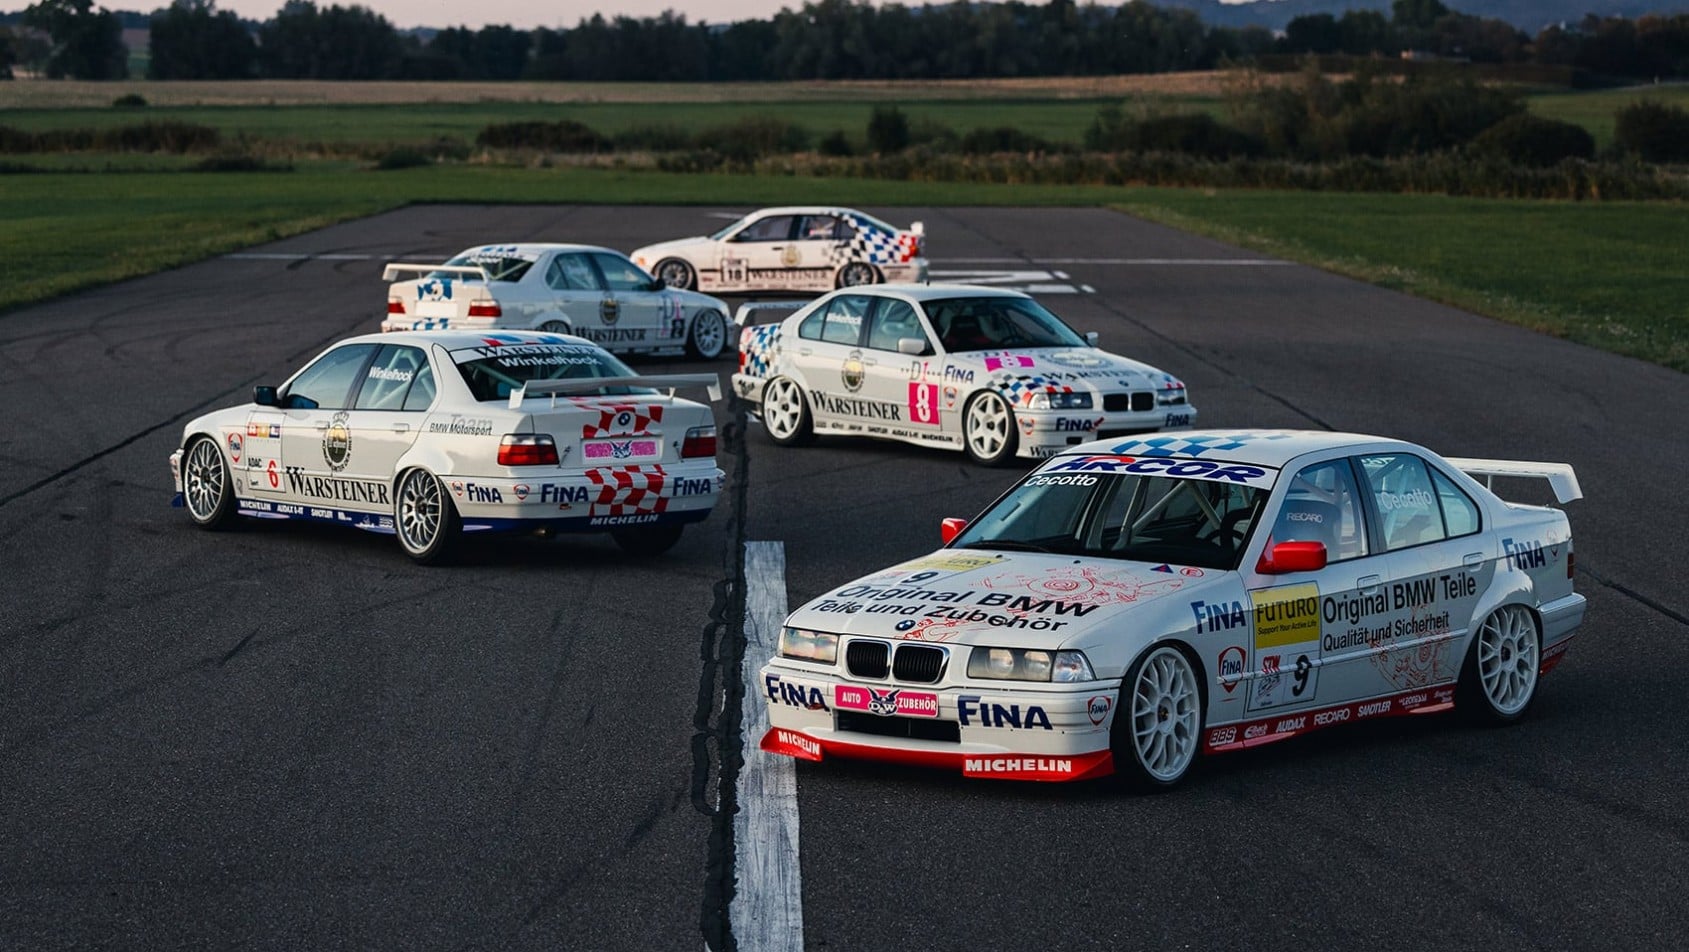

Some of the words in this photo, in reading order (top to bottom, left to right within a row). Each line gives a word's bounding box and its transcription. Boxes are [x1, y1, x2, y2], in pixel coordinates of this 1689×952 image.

[498, 356, 602, 368] Winkelhock
[368, 366, 413, 382] Winkelhock
[944, 364, 974, 384] FINA
[810, 389, 900, 421] WARSTEINER
[917, 383, 931, 422] 8
[430, 422, 449, 432] BMW
[449, 424, 492, 437] Motorsport
[1055, 417, 1092, 432] FINA
[1165, 413, 1190, 427] FINA
[267, 460, 279, 488] 6
[1045, 456, 1266, 483] ARCOR
[286, 466, 390, 504] WARSTEINER
[672, 476, 711, 496] FINA
[1024, 473, 1098, 487] Cecotto
[466, 483, 503, 503] FINA
[541, 483, 589, 502] FINA
[1380, 488, 1432, 510] Cecotto
[590, 513, 659, 525] MICHELIN
[1286, 512, 1323, 523] RECARO
[1502, 538, 1546, 572] FINA
[836, 585, 976, 602] Original
[976, 592, 1100, 617] BMW
[1323, 587, 1389, 625] Original
[1394, 577, 1436, 610] BMW
[1440, 572, 1476, 600] Teile
[866, 604, 927, 615] und
[924, 605, 1068, 631] Zubehör
[1191, 601, 1246, 634] FINA
[1257, 597, 1317, 623] FUTURO
[1323, 628, 1371, 651] Qualität
[1371, 622, 1392, 640] und
[1394, 611, 1450, 636] Sicherheit
[1222, 659, 1241, 674] FINA
[1292, 655, 1311, 697] 9
[765, 675, 830, 712] FINA
[842, 692, 861, 704] AUTO
[898, 696, 937, 711] ZUBEHÖR
[957, 695, 1053, 730] FINA
[1313, 708, 1350, 726] RECARO
[1275, 716, 1306, 733] AUDAX
[778, 731, 821, 756] MICHELIN
[1209, 727, 1237, 747] BBS
[965, 759, 1071, 772] MICHELIN
